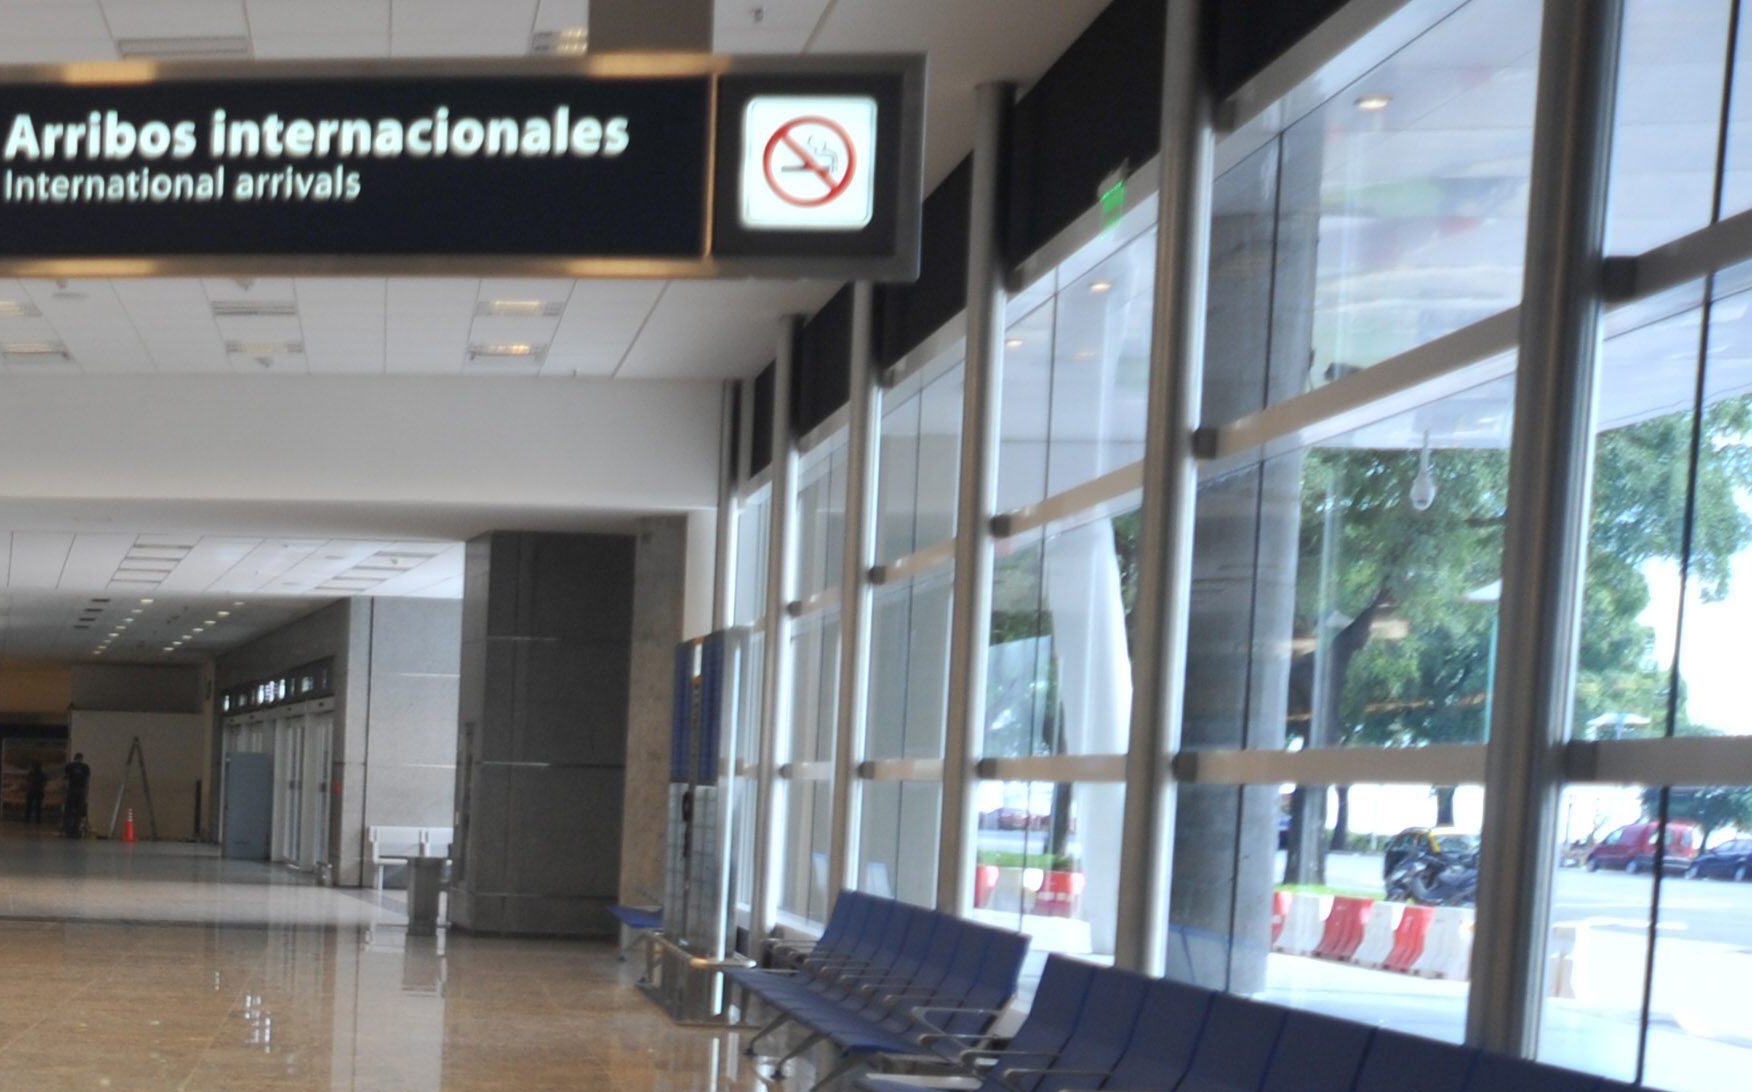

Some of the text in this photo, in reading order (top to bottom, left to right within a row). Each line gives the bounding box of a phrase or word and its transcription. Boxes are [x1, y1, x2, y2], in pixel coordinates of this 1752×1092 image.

[3, 105, 630, 161] Arribos internacionales
[4, 163, 361, 202] International arrivals
